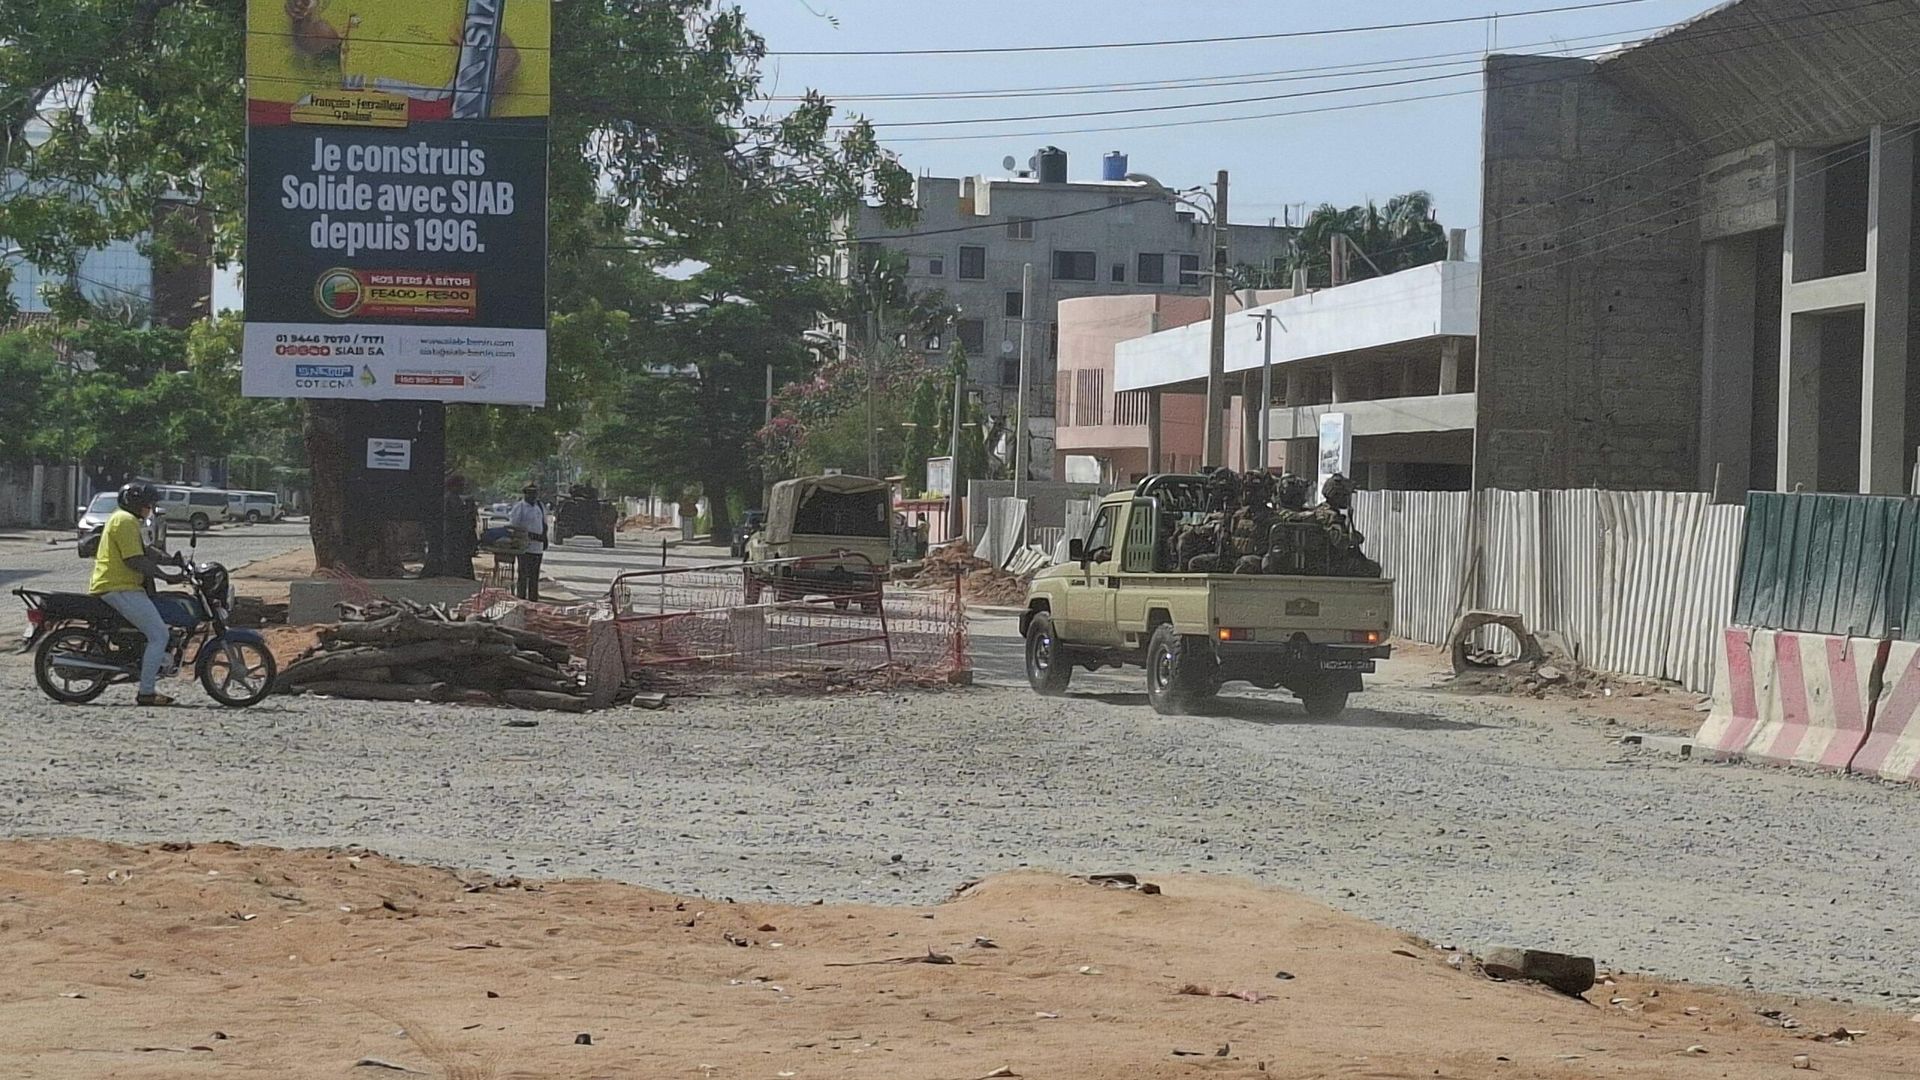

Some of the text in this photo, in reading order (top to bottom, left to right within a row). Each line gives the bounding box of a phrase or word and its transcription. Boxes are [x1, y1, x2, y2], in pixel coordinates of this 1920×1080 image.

[312, 137, 486, 176] Je construis
[282, 174, 514, 215] Solide avec SIAB
[310, 213, 485, 257] depuis 1996.
[371, 276, 393, 284] NOS
[396, 276, 422, 286] FERS
[276, 334, 287, 343] 01
[335, 346, 385, 356] SIAB SA
